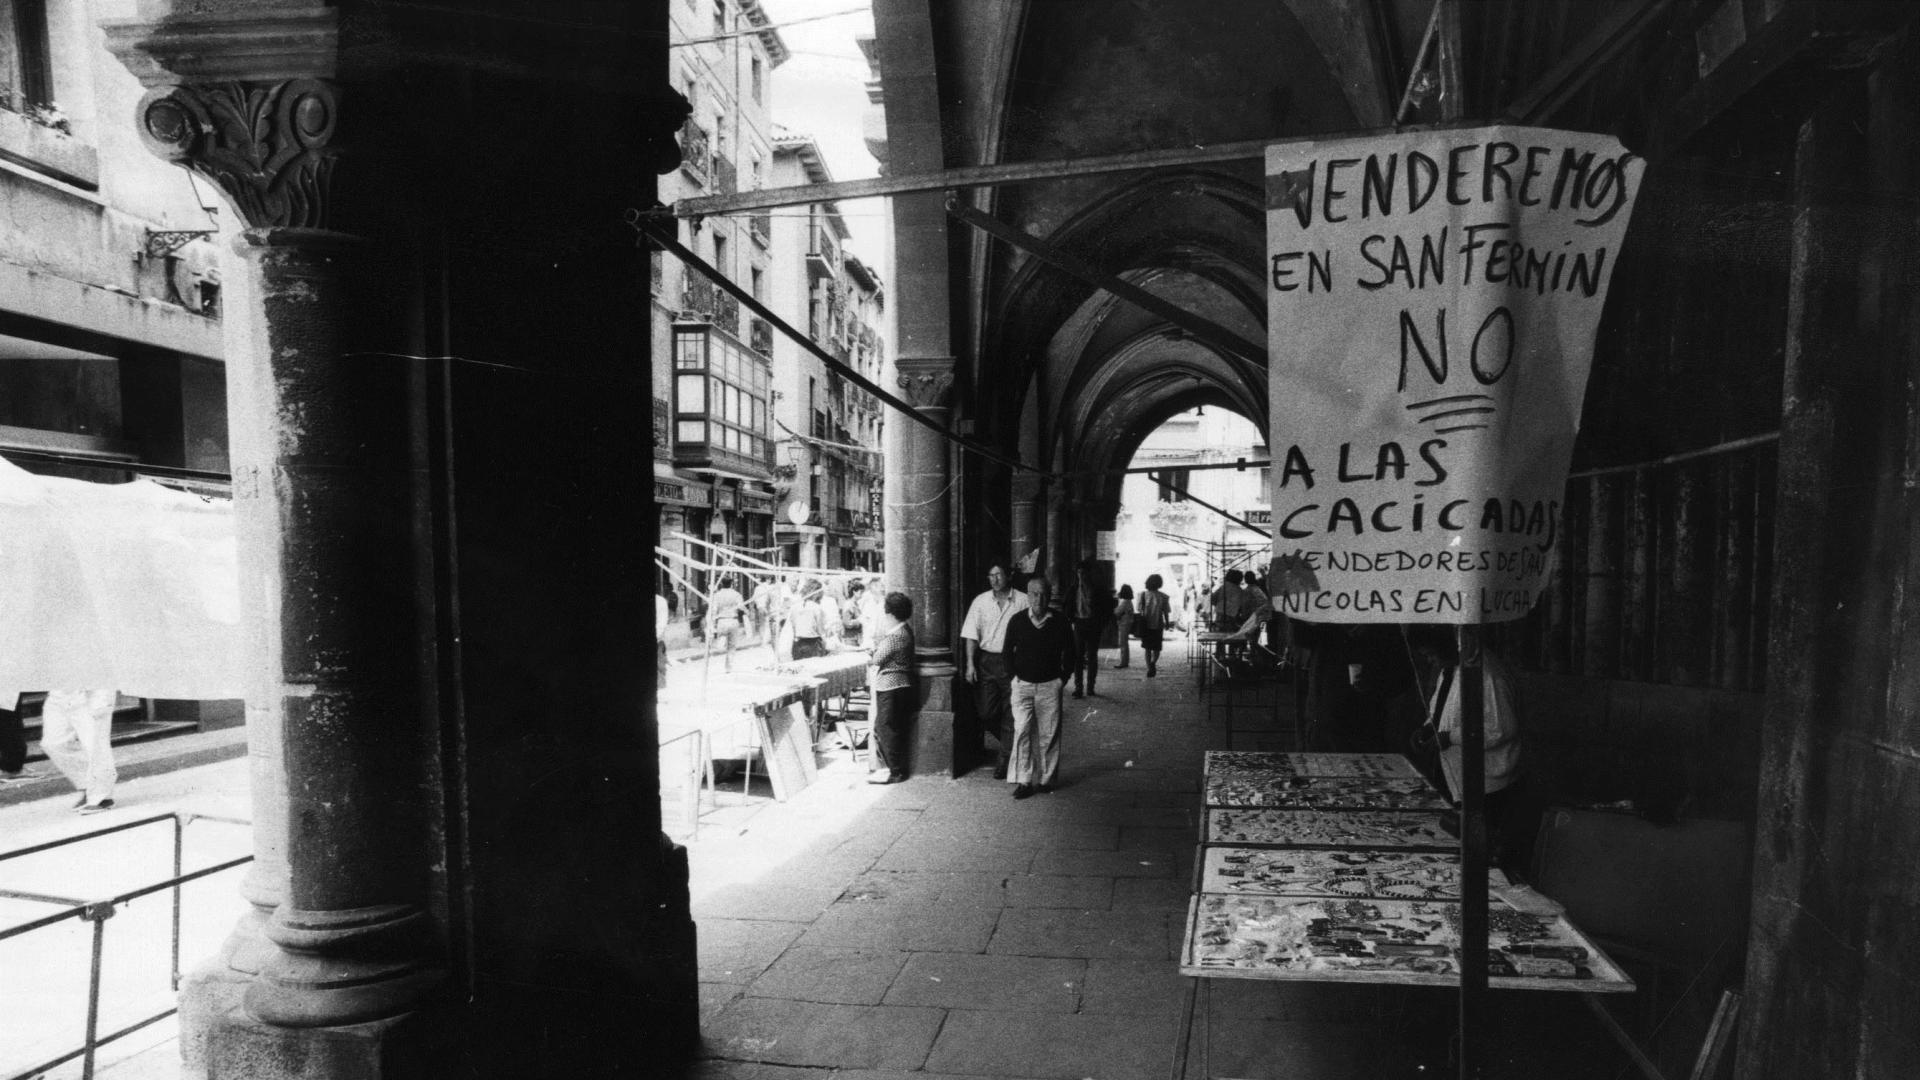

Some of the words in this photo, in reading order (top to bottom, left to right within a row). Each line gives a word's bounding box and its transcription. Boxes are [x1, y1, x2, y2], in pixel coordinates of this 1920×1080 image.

[1282, 141, 1637, 229] VENDEREMOS
[1271, 249, 1331, 293] EN
[1357, 225, 1448, 290] SAN
[1397, 305, 1515, 393] NO
[1280, 444, 1315, 490] A
[1337, 438, 1448, 487] LAS
[1282, 548, 1491, 572] ENDEDORES
[1497, 551, 1518, 572] DE
[1282, 590, 1403, 613] NICOLAS
[1413, 590, 1463, 614] EN
[1481, 587, 1530, 614] LUCHA
